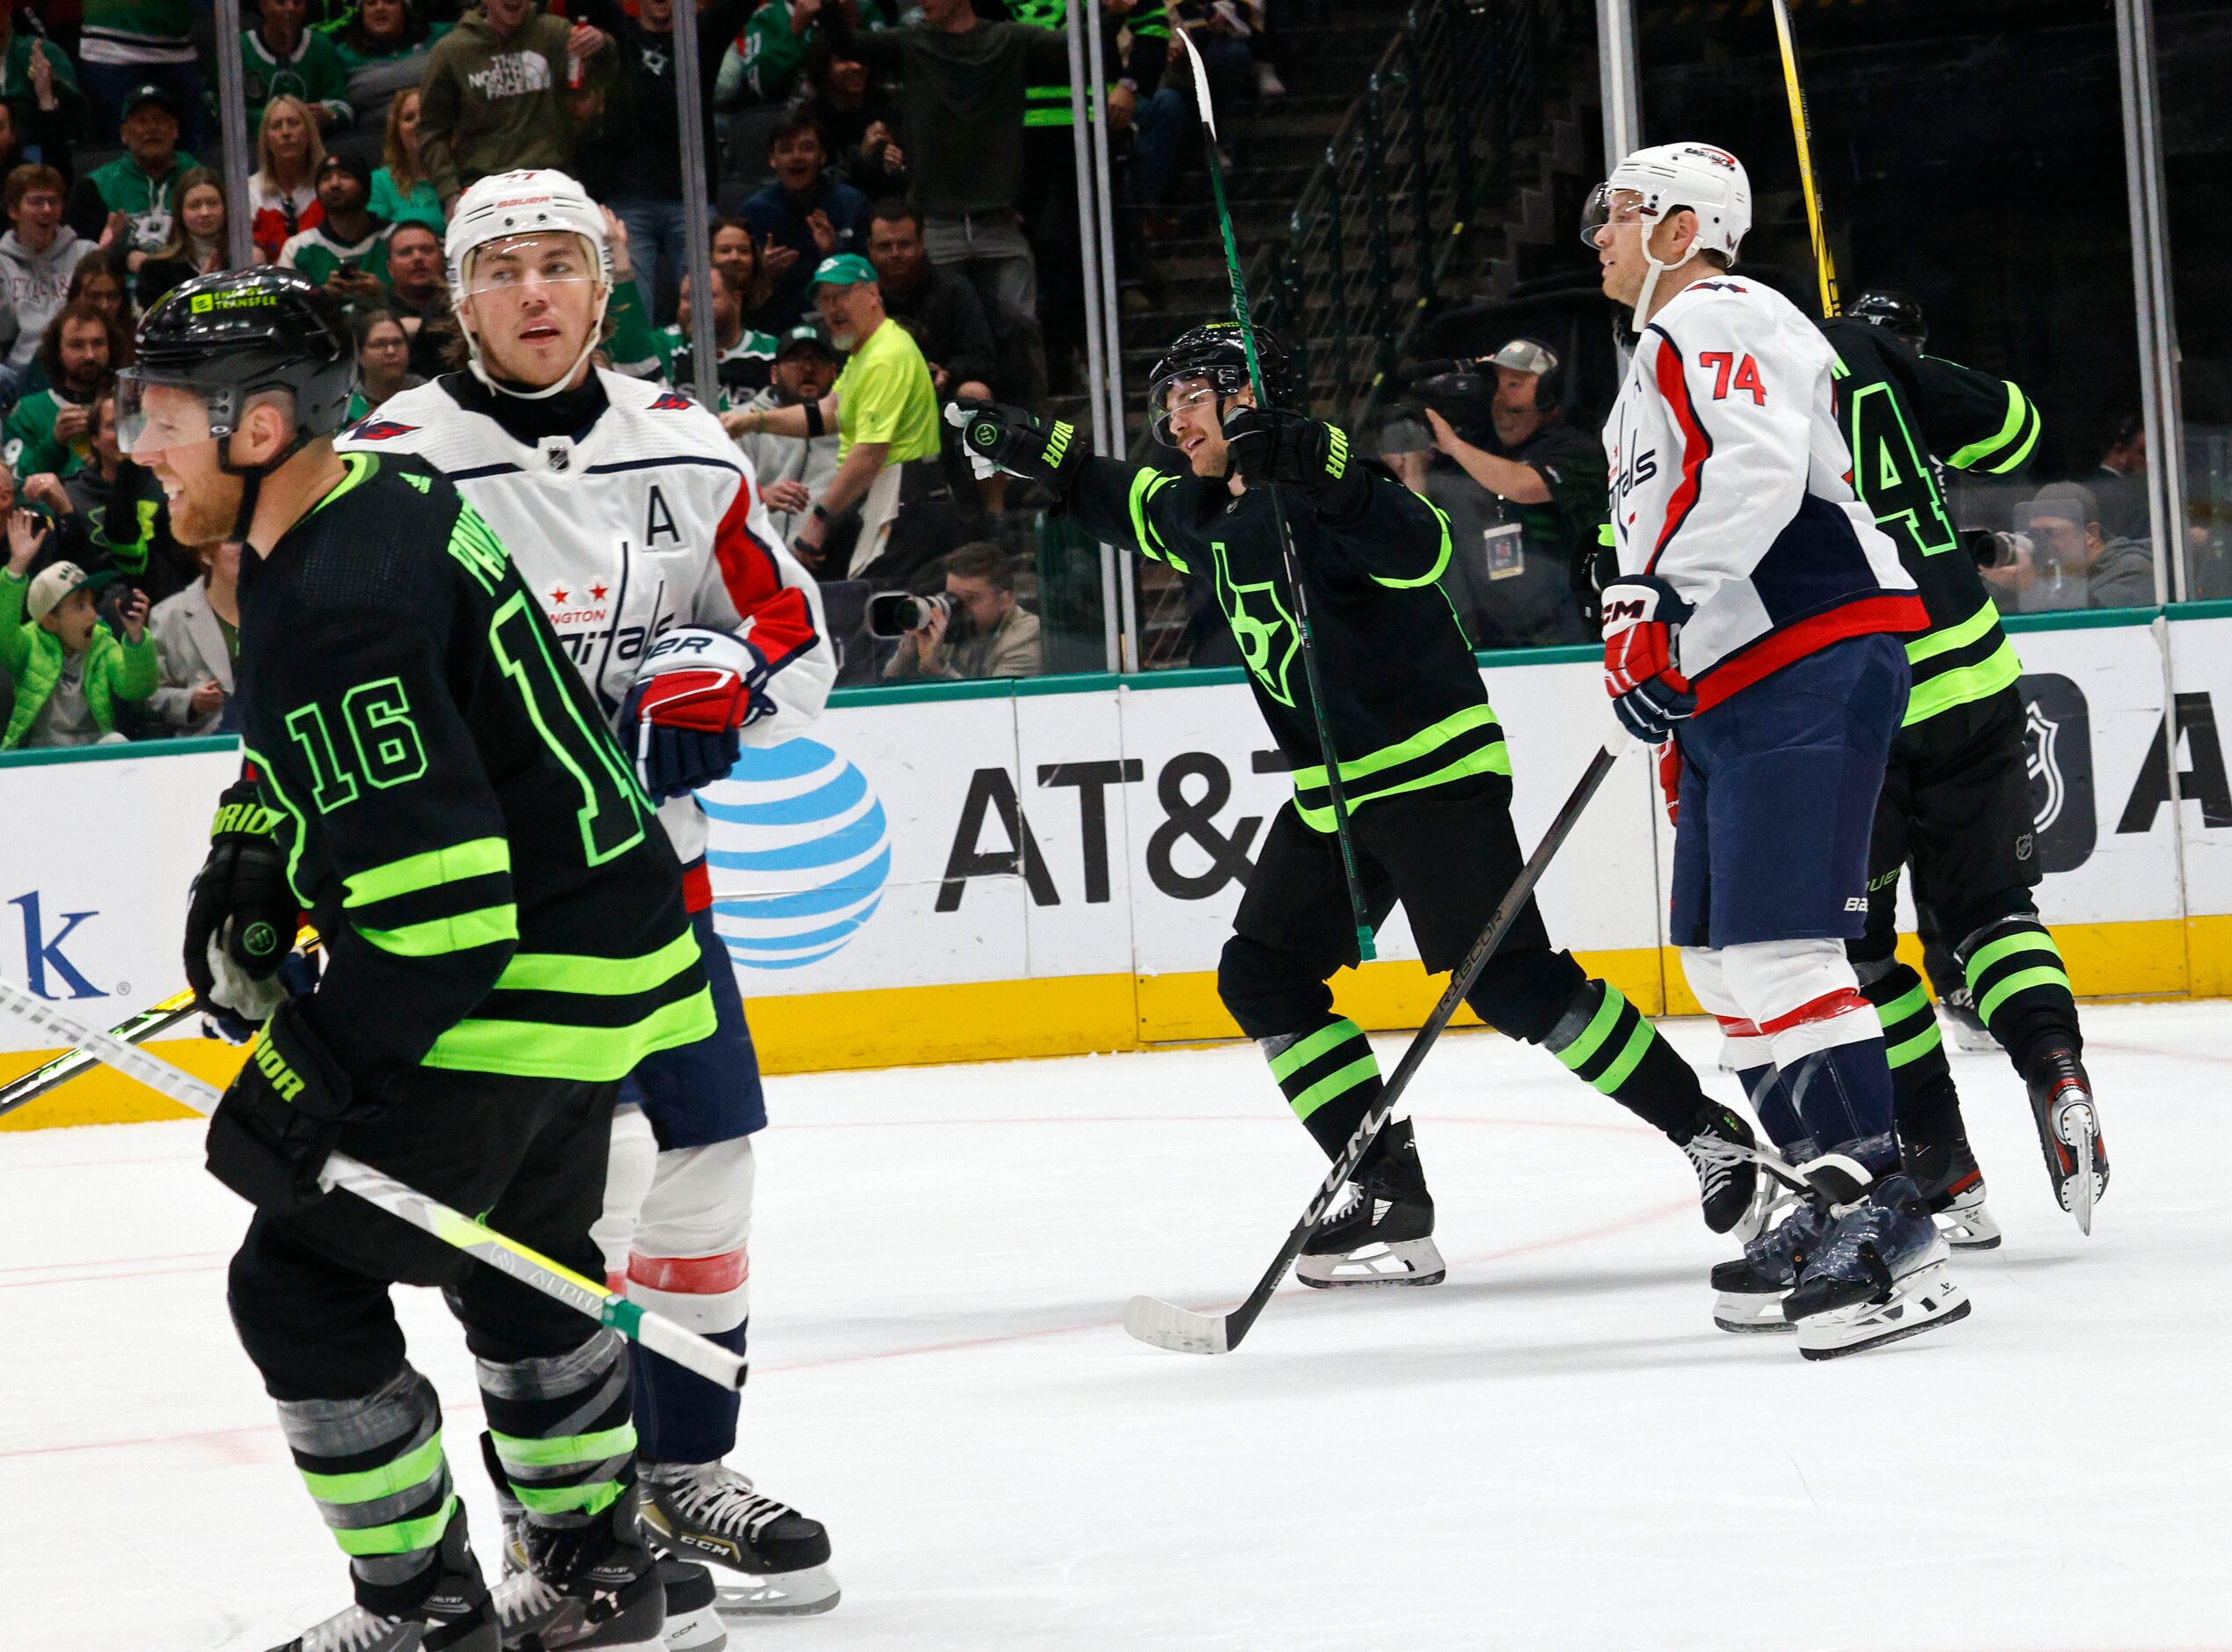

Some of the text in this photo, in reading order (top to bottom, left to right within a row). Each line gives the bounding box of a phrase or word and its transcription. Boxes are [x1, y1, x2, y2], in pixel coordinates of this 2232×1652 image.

[1699, 351, 1767, 406] 74
[646, 485, 681, 547] A
[284, 676, 429, 815] 16
[1303, 1109, 1375, 1227] CCM
[680, 1535, 730, 1556] CCM
